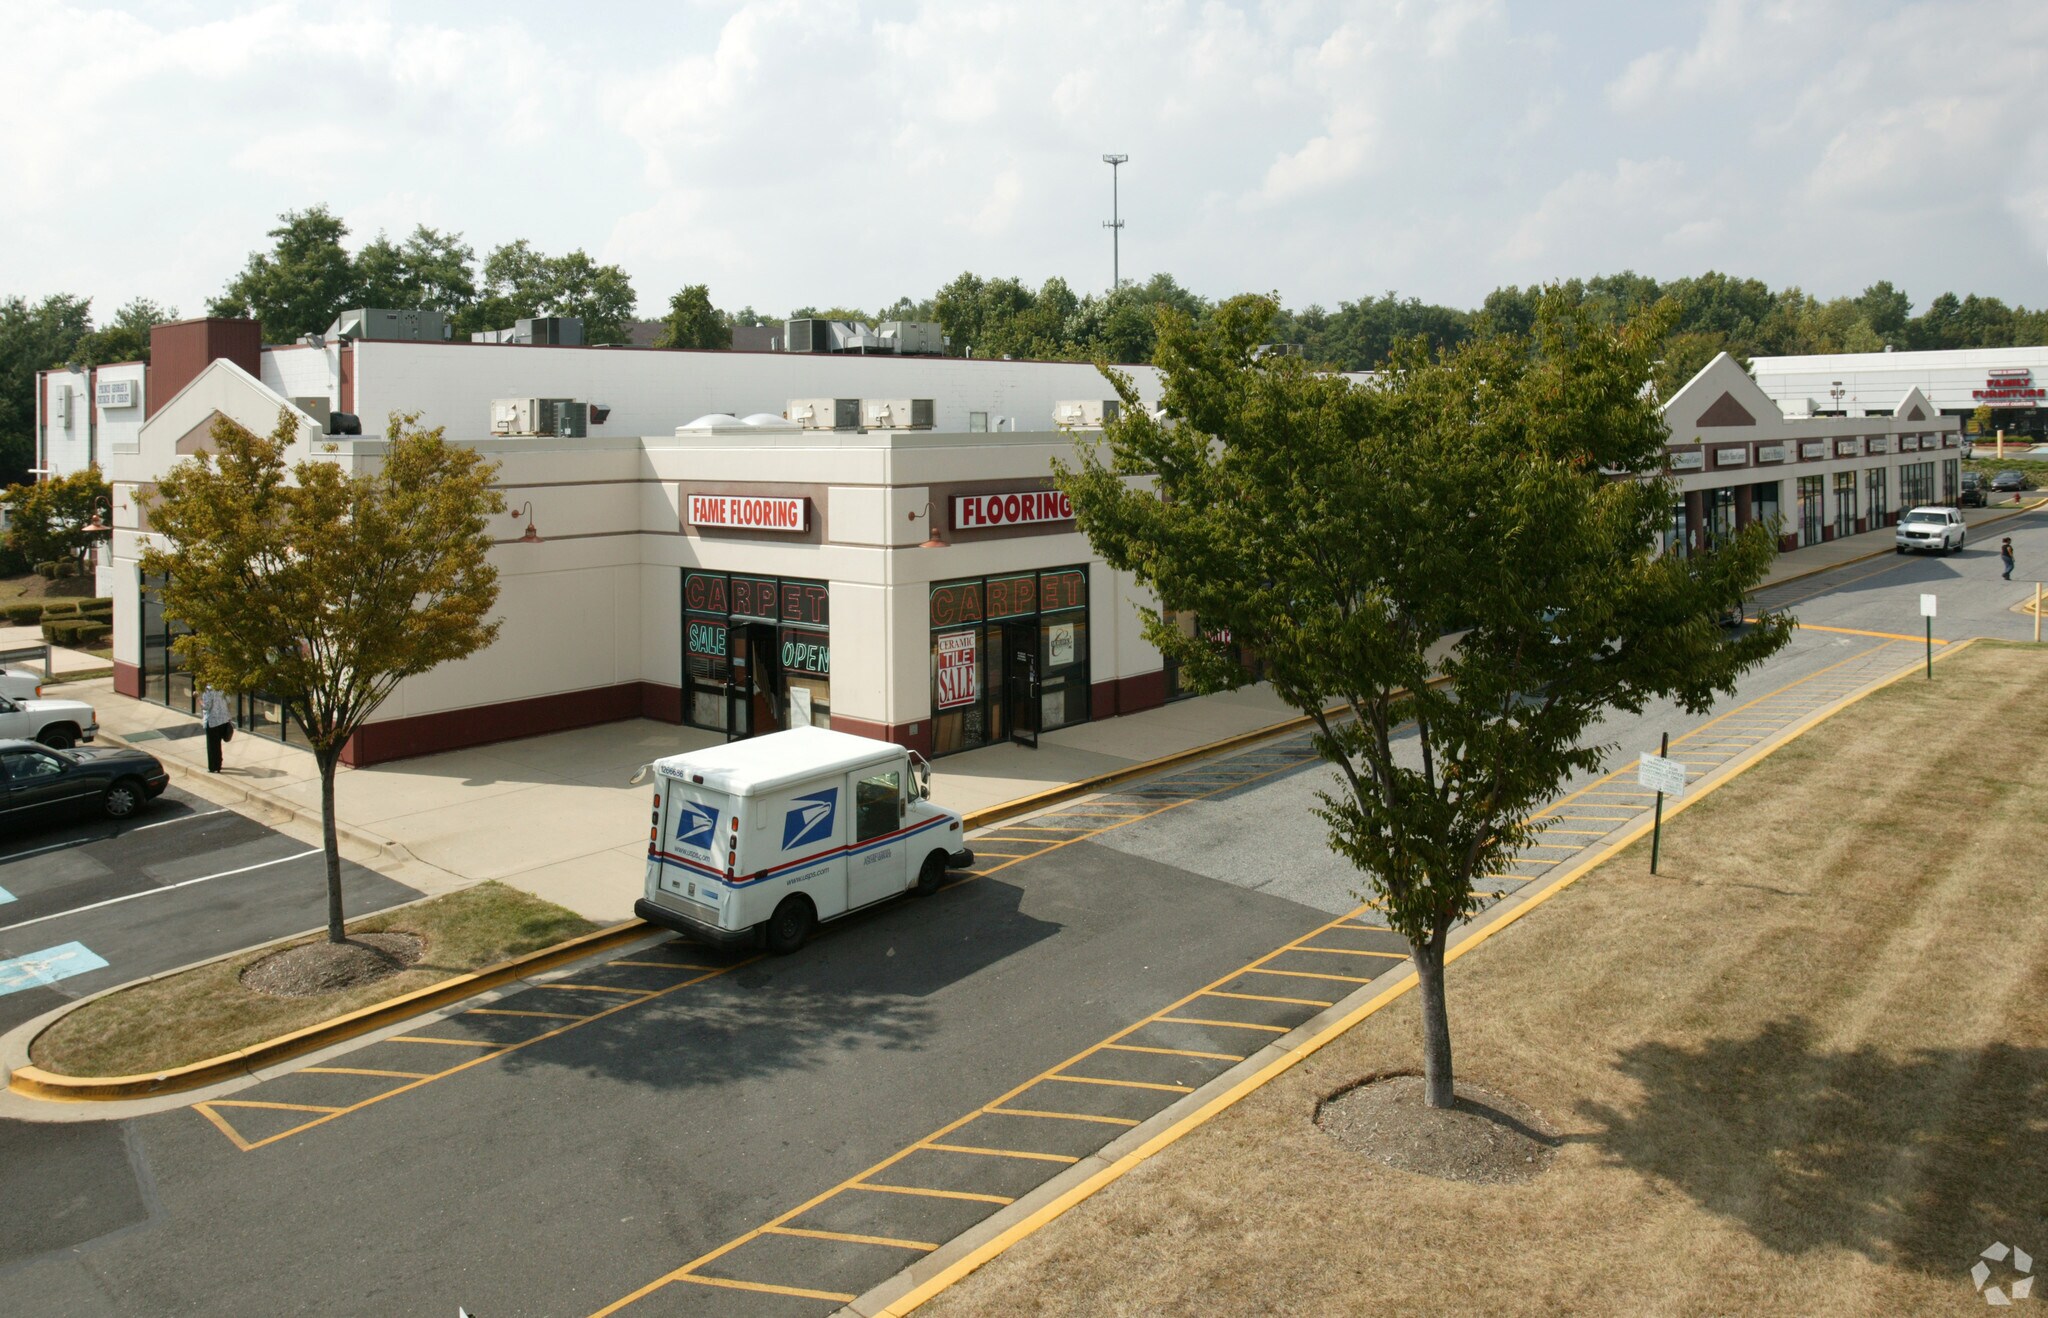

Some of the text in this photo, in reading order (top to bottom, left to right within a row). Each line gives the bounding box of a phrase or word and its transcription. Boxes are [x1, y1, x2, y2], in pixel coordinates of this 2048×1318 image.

[1973, 389, 2046, 398] FURNITURE
[1987, 378, 2030, 387] FAMILY
[693, 497, 798, 527] FAME FLOORING
[963, 492, 1073, 526] FLOORING
[686, 576, 826, 622] CARPET
[931, 573, 1082, 626] CARPET
[690, 623, 726, 656] SALE
[940, 636, 975, 651] CERAMIC
[782, 641, 830, 673] OPEN
[943, 649, 971, 667] TILE
[940, 665, 975, 704] SALE
[786, 867, 830, 886] www.usps.com
